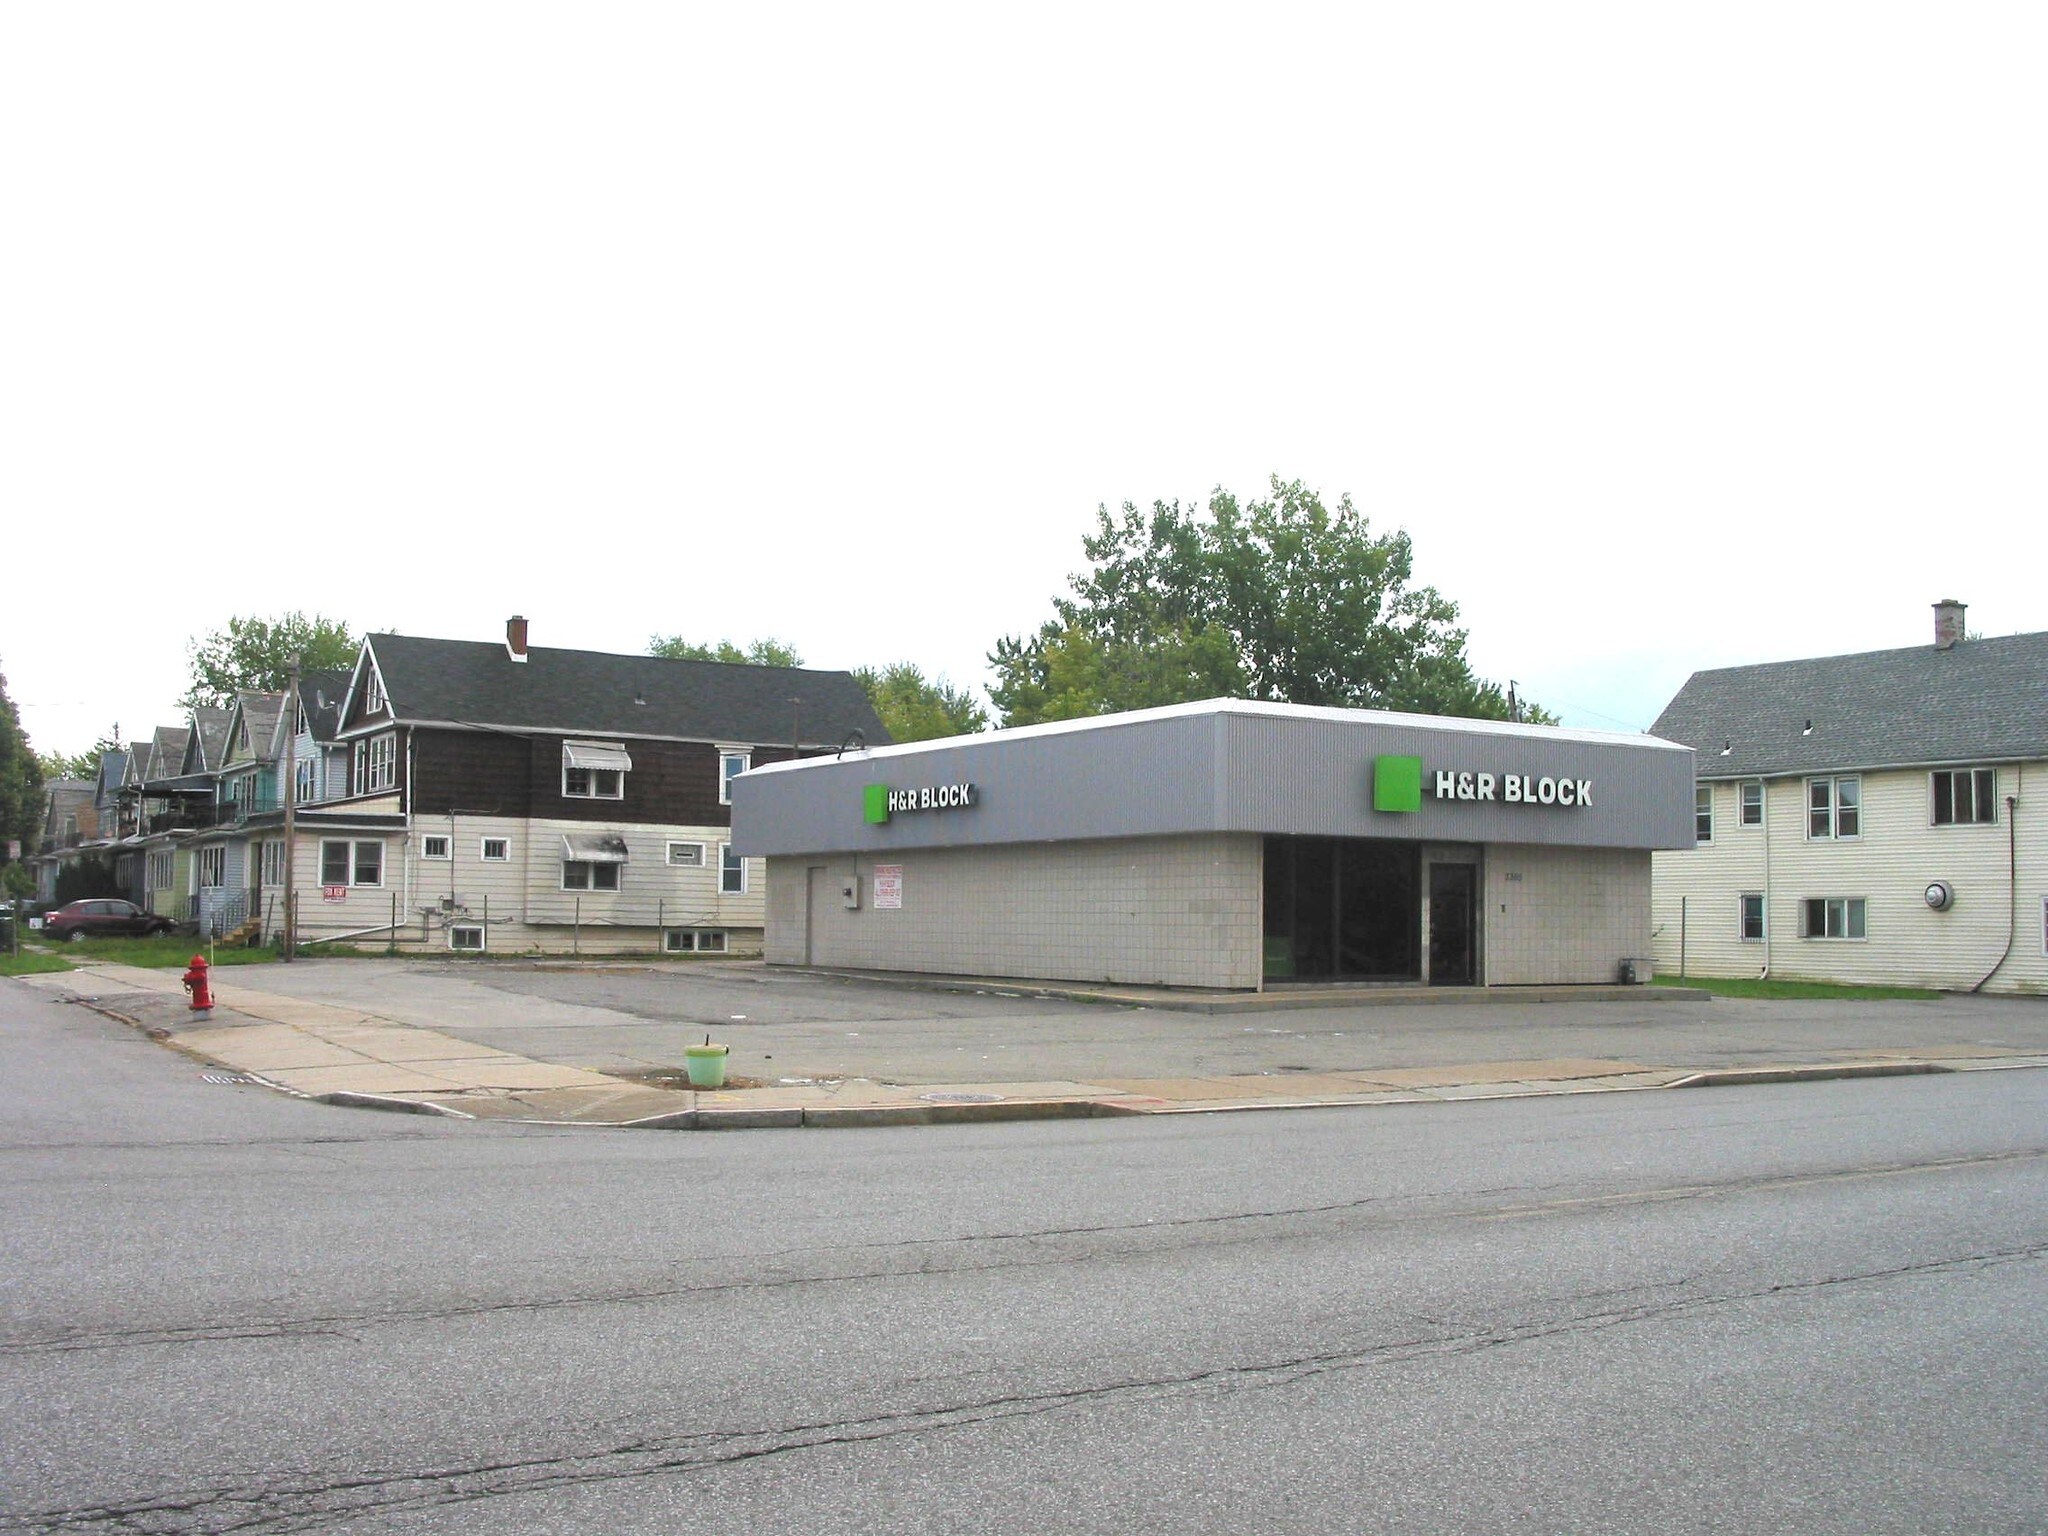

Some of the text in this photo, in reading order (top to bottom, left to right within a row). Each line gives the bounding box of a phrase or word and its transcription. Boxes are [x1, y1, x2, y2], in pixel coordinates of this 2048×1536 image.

[888, 783, 970, 812] H&R BLOCK
[1436, 770, 1593, 807] H&R BLOCK
